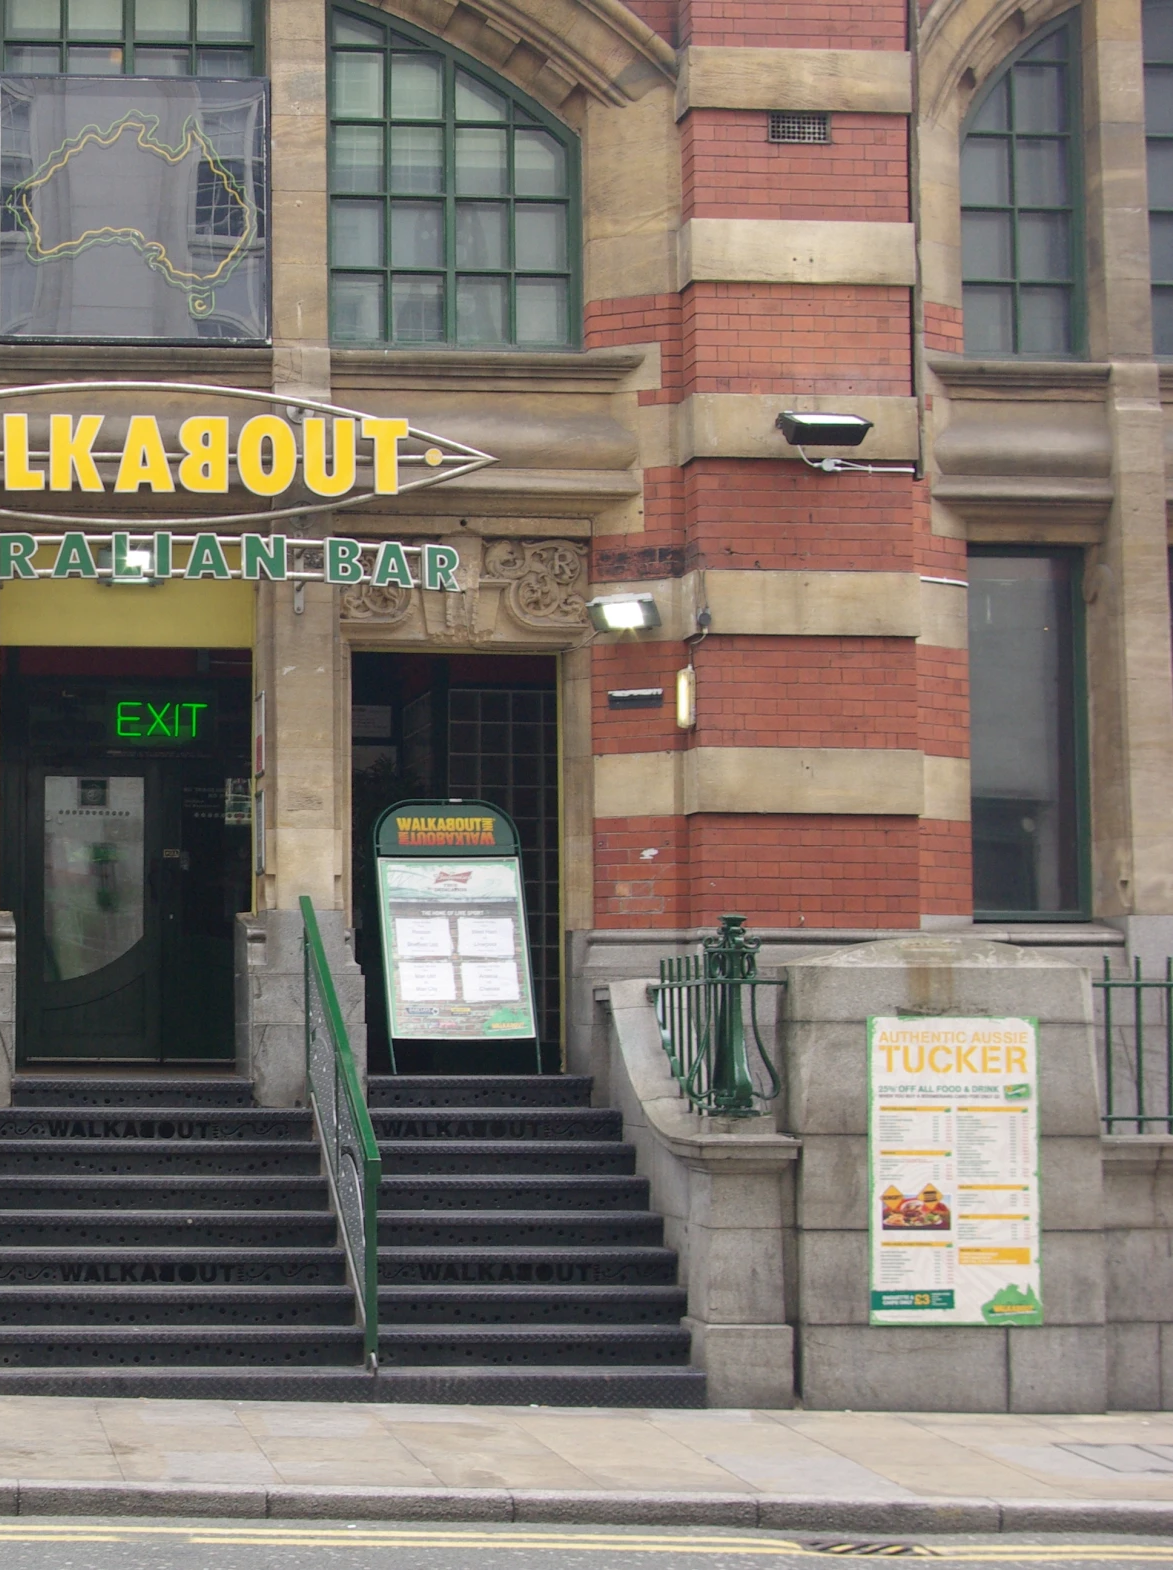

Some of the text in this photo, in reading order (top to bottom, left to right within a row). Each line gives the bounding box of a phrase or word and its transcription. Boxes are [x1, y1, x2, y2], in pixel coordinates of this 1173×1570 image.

[324, 536, 460, 592] BAR
[116, 701, 208, 737] EXIT
[395, 817, 482, 832] WALKABOUT
[879, 1031, 1028, 1044] AUTHENTIC AUSSIE
[878, 1045, 1028, 1073] TUCKER
[898, 1085, 917, 1093] OFF
[918, 1085, 934, 1093] ALL
[936, 1085, 962, 1093] FOOD
[971, 1085, 1001, 1093] DRINK
[48, 1120, 212, 1139] WALKABOUT
[381, 1121, 544, 1139] WALKABOUT
[58, 1263, 235, 1283] WALKABOUT
[418, 1263, 592, 1282] WALKABOUT
